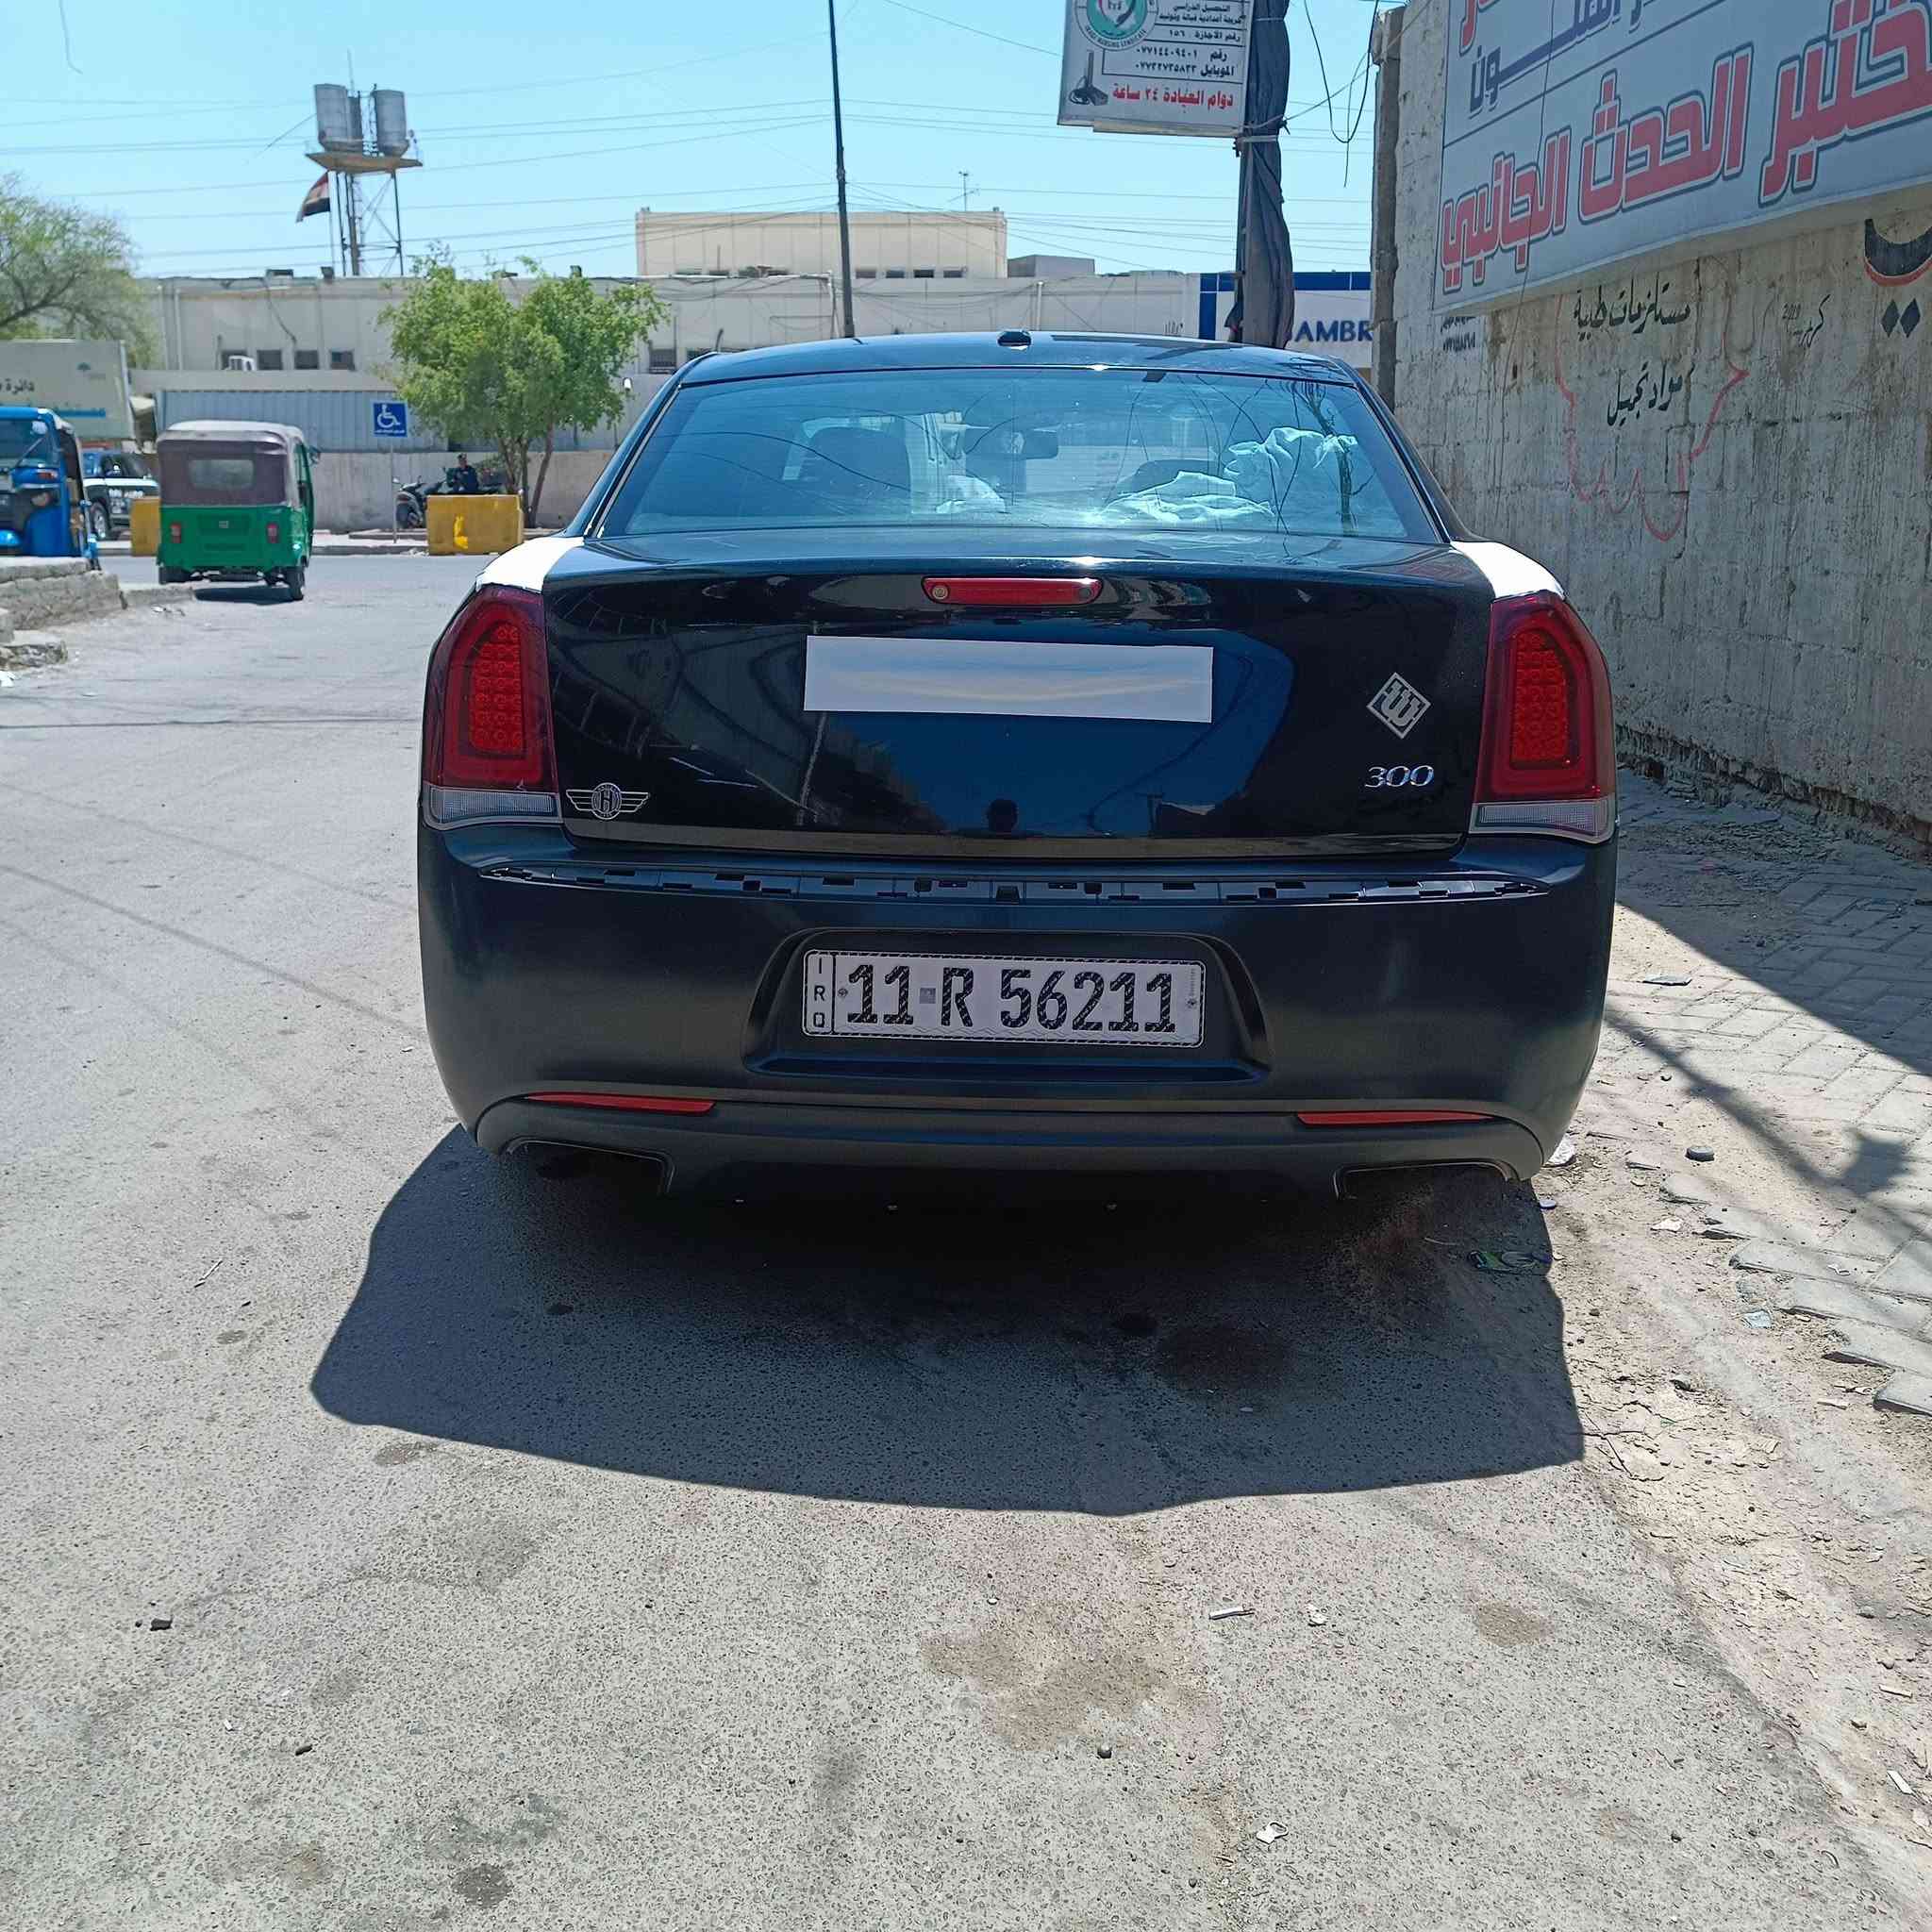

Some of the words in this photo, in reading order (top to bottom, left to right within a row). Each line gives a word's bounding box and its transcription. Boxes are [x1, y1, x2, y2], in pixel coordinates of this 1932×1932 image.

[1209, 48, 1227, 62] رقم
[1225, 31, 1241, 42] رقم
[1201, 63, 1234, 77] الموبايل
[1112, 82, 1141, 100] ساعة
[1145, 86, 1158, 101] ٢٤
[1162, 86, 1205, 113] العيادة
[1208, 90, 1234, 109] دوام
[1758, 0, 1932, 208] ختبر
[1578, 45, 1754, 225] الحدث
[1441, 125, 1572, 294] الجانبي
[1574, 284, 1607, 341] طبية
[1608, 272, 1691, 334] مستلزمات
[1607, 360, 1649, 426] تجميل
[1648, 361, 1683, 411] مواد
[1364, 765, 1435, 788] 300
[847, 963, 914, 1025] 11
[941, 966, 974, 1028] R
[999, 969, 1176, 1033] 56211
